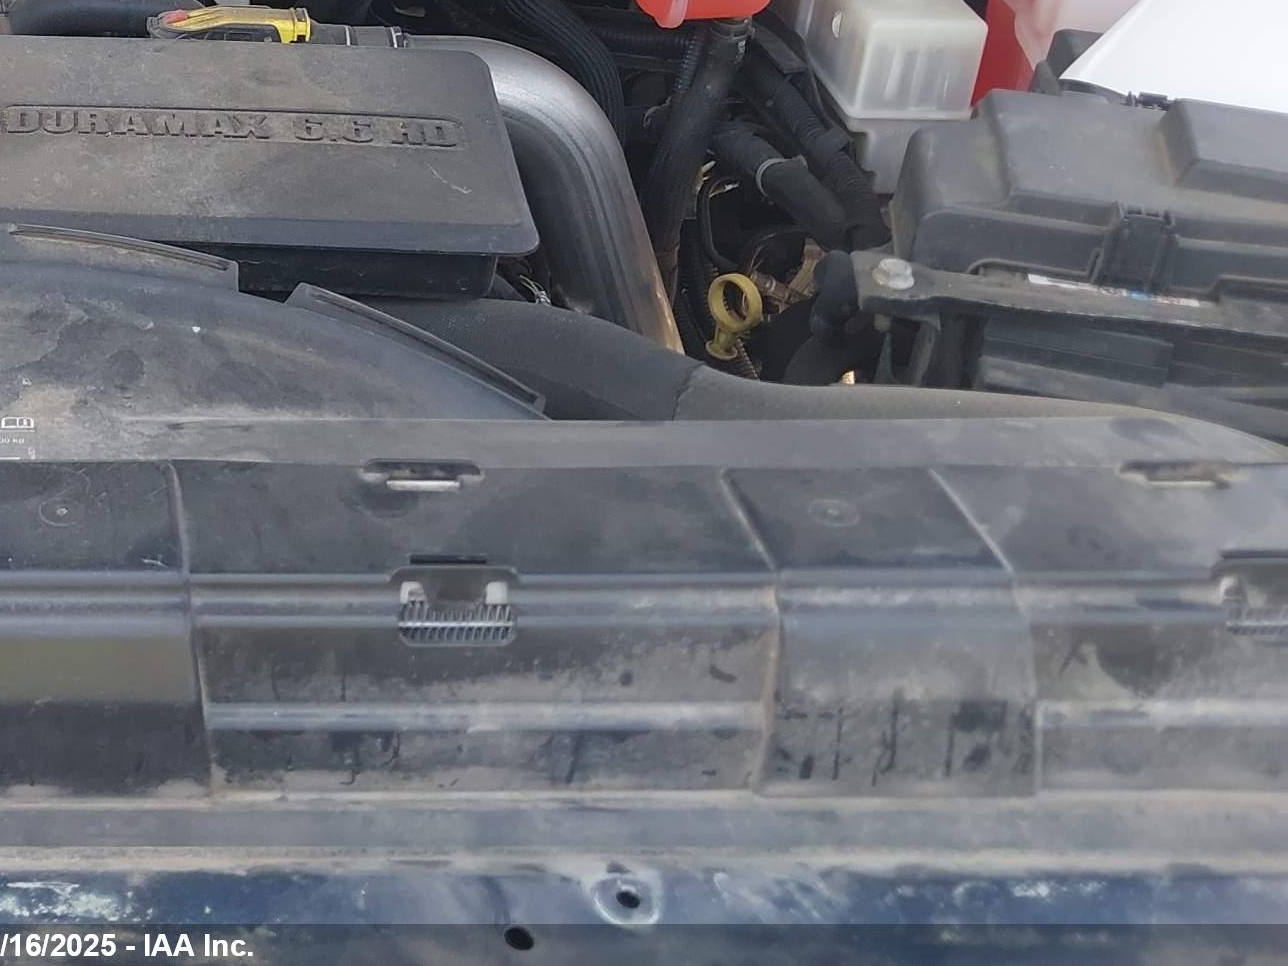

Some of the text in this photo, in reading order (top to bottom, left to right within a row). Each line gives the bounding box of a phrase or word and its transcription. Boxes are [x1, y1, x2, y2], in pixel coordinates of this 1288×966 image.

[6, 110, 459, 148] DURAMAX 6.6 HD
